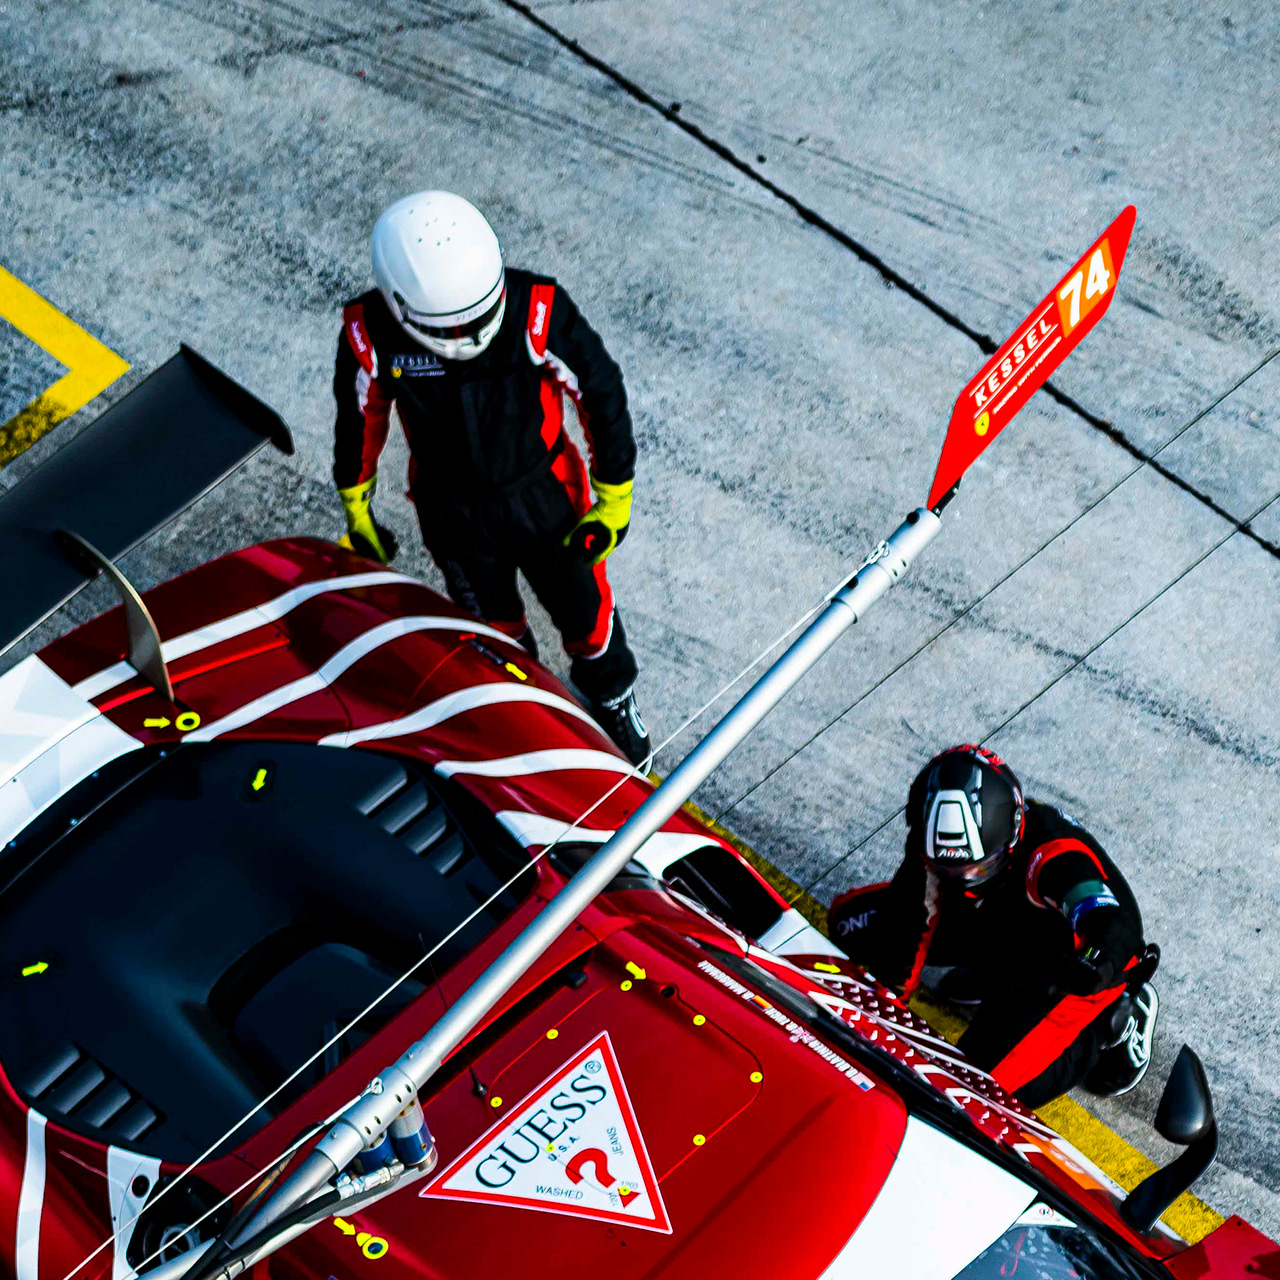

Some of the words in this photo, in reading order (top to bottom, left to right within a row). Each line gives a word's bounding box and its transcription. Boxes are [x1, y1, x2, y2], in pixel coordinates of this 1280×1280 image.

[1059, 248, 1110, 328] 74
[974, 319, 1052, 407] KESSEL
[475, 1074, 607, 1188] GUESS
[606, 1126, 624, 1156] JEANS
[535, 1184, 584, 1200] WASHED
